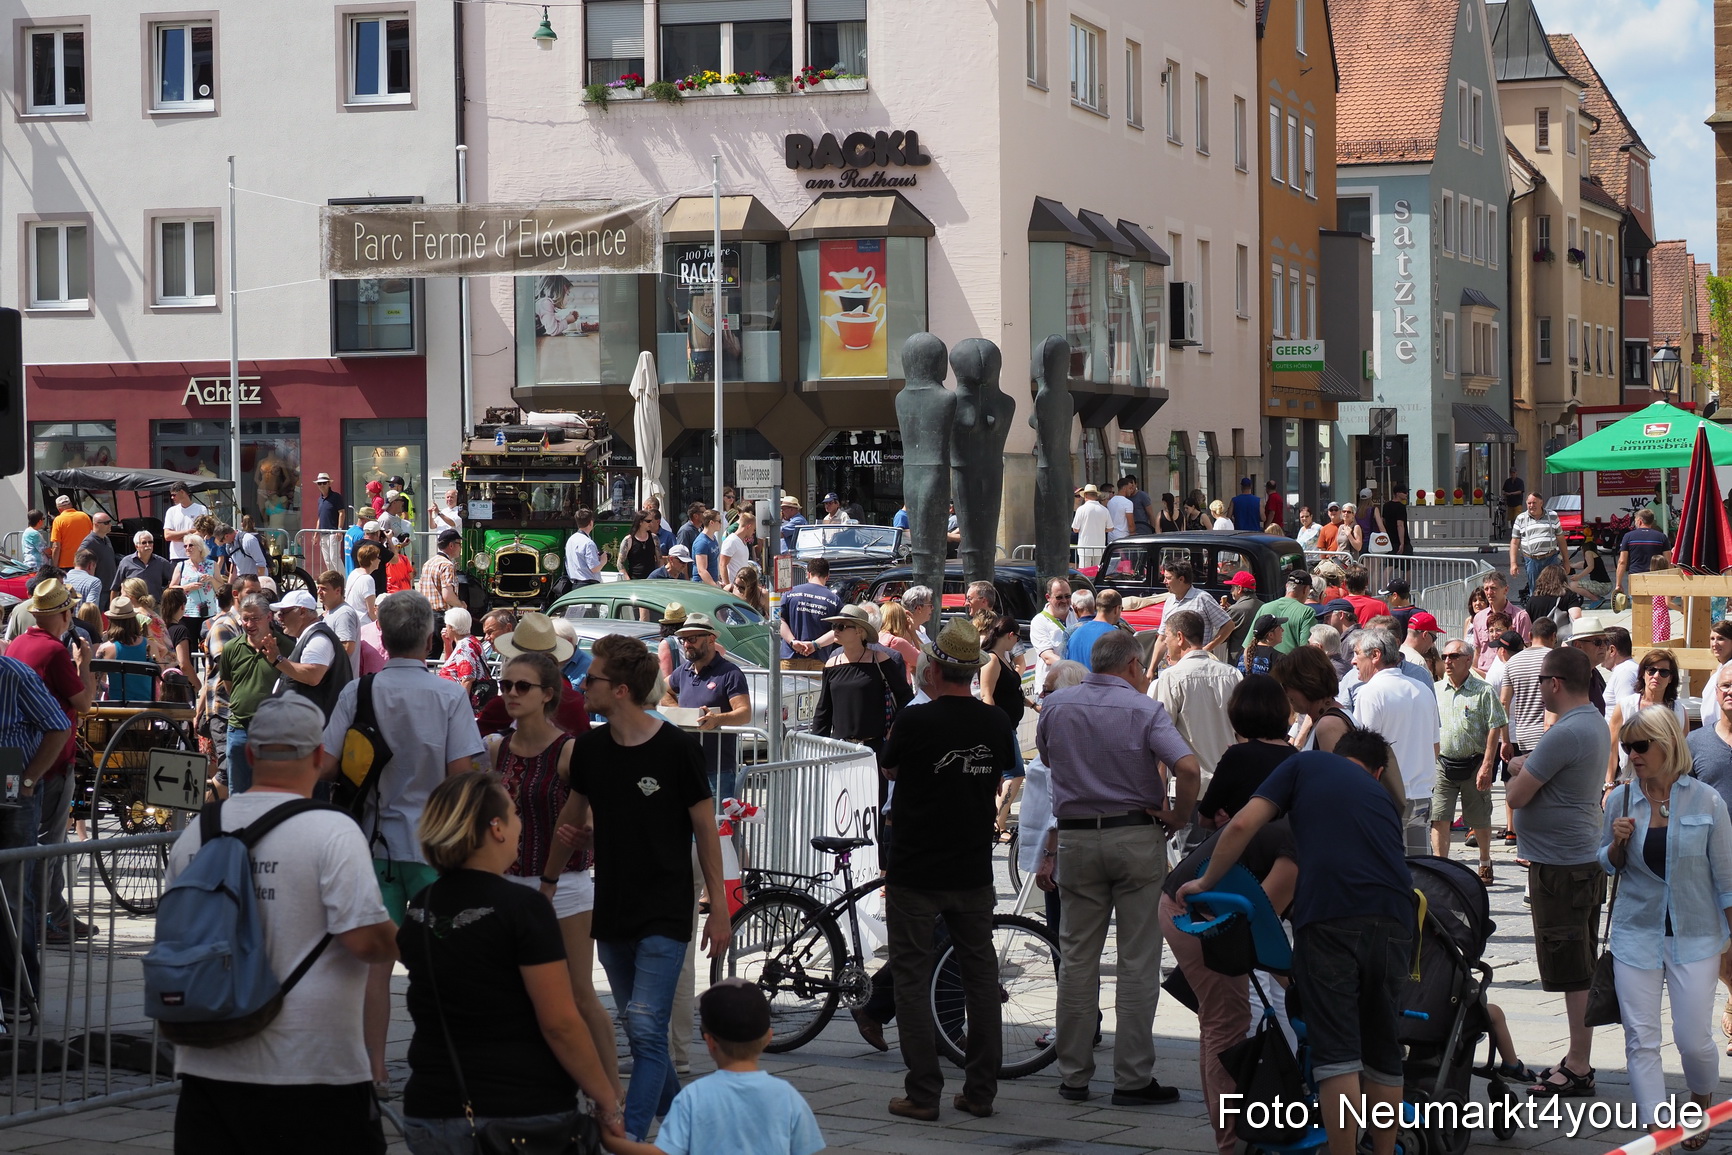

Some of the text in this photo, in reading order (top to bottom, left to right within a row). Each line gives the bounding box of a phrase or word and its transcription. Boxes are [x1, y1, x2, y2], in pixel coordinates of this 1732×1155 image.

[785, 130, 931, 170] RACKL
[805, 168, 917, 189] am Rathaus
[354, 218, 627, 270] Parc Fermé d'Elégance
[685, 247, 731, 261] 100 Jare
[681, 262, 724, 284] RACK
[1392, 199, 1419, 364] satzke
[1275, 345, 1312, 356] GEERS
[1623, 437, 1688, 445] Neumarkter
[371, 447, 401, 458] Achatz
[853, 450, 882, 465] RACKL
[1630, 497, 1649, 508] WC
[962, 757, 993, 776] Express
